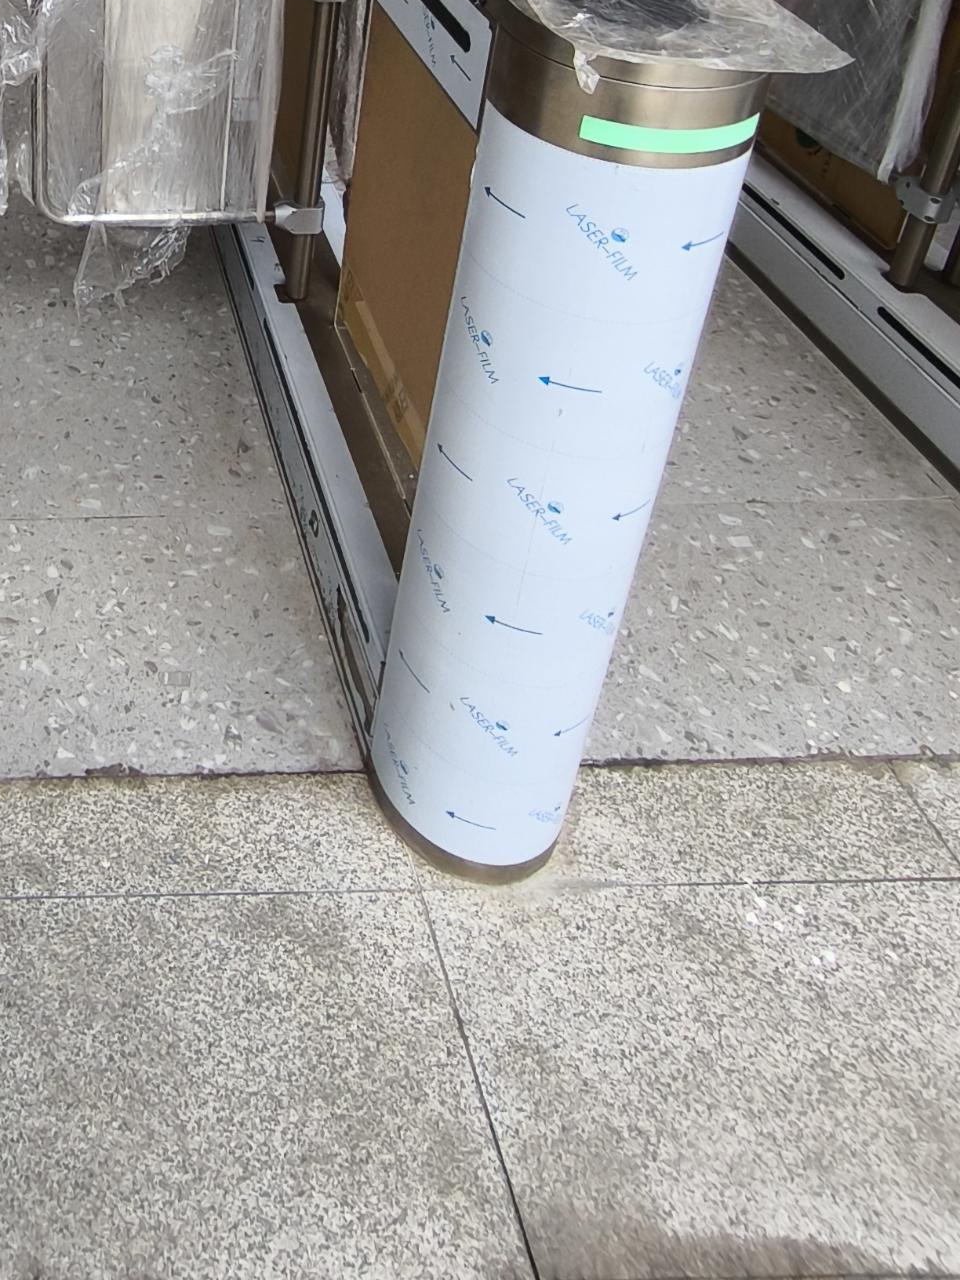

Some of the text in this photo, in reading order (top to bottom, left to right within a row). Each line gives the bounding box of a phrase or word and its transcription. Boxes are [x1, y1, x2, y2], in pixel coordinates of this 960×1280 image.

[565, 203, 638, 282] LASER-FILM
[460, 296, 499, 385] LASER-FILM
[506, 477, 573, 545] LASER-FILM
[459, 696, 520, 758] LASER-FILM
